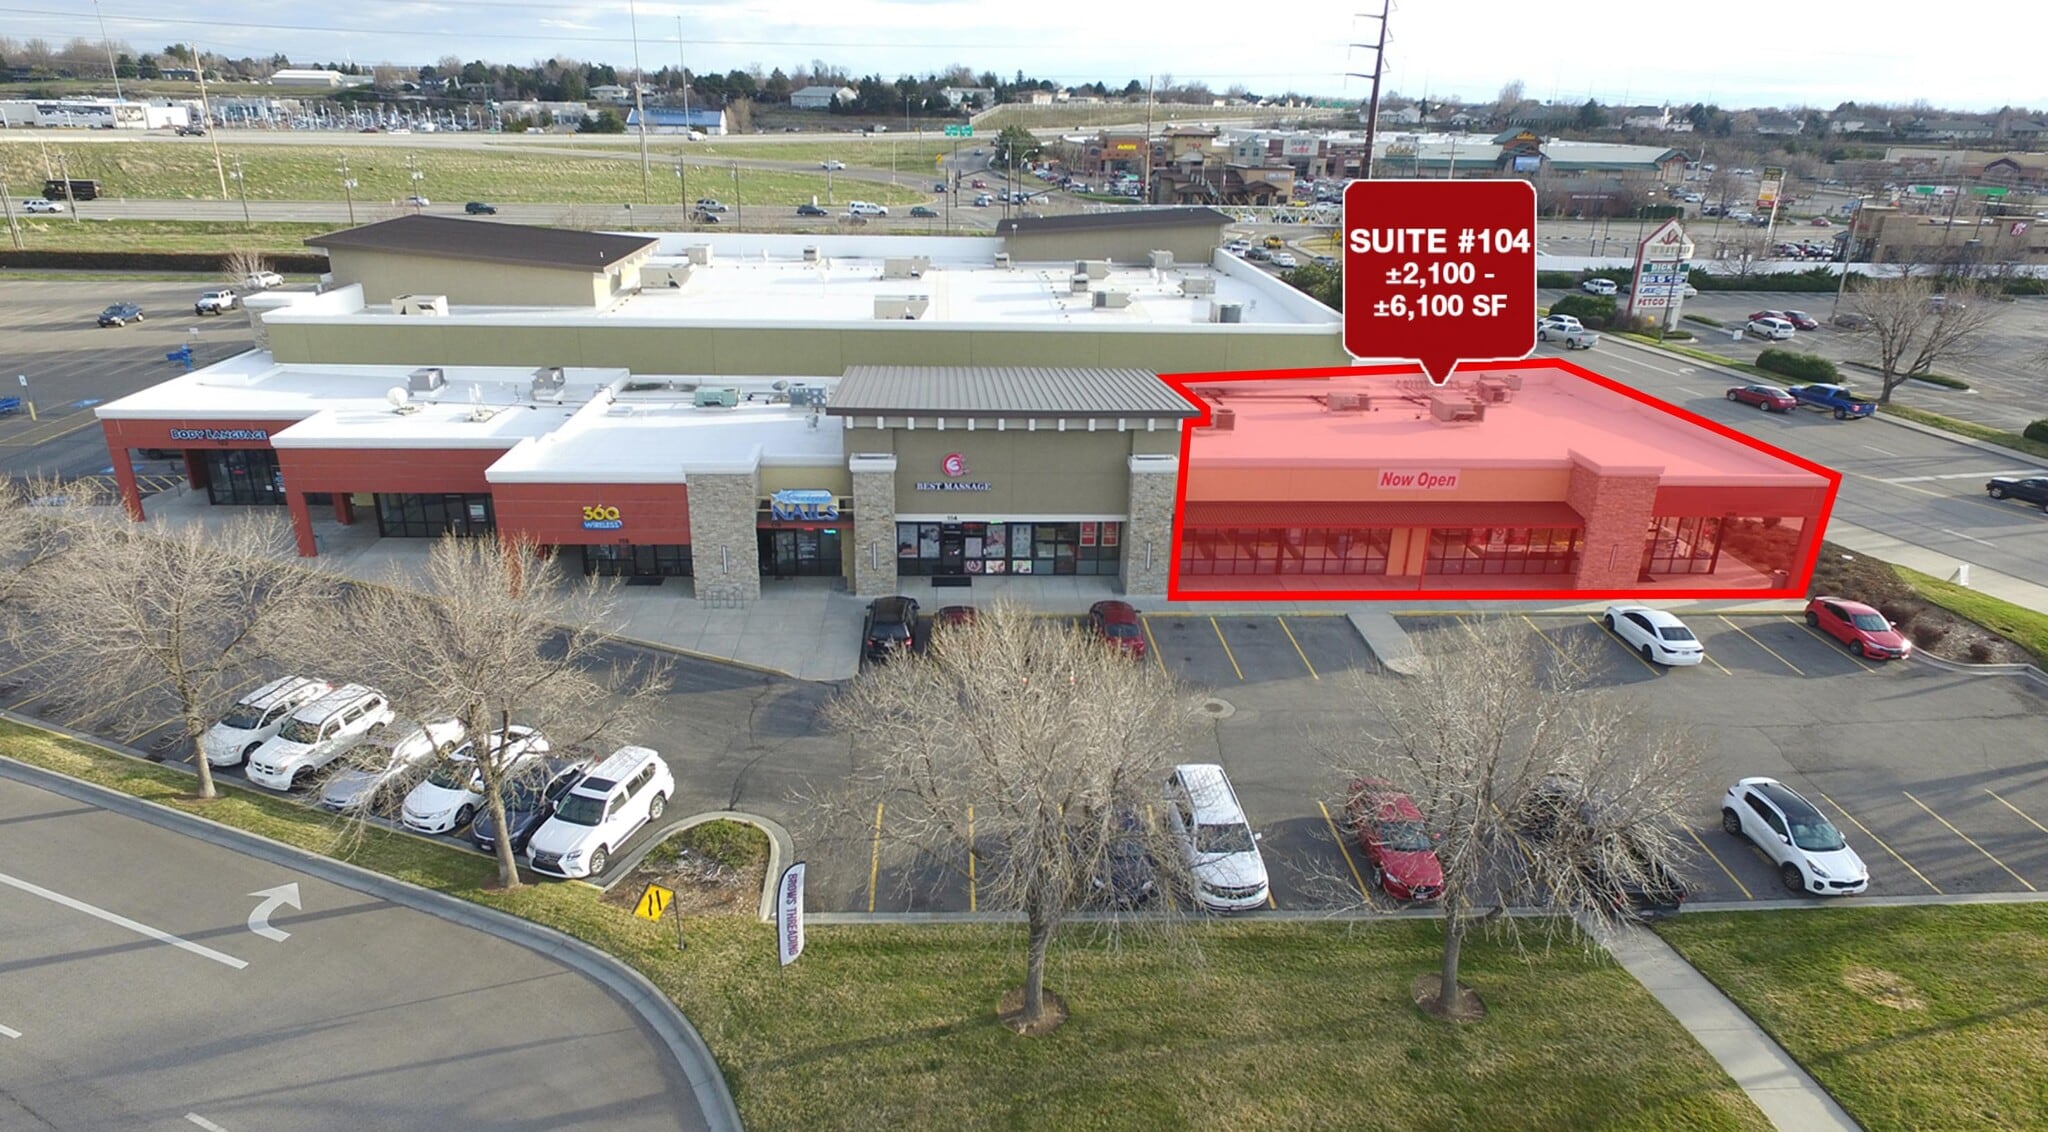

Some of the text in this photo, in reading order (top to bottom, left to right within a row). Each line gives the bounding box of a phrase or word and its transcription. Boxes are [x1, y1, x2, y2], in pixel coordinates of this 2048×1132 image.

[1637, 298, 1665, 306] PETCO
[916, 482, 993, 491] BEST MASSAGE
[1380, 472, 1457, 489] Now Open
[582, 504, 620, 521] 360
[771, 503, 839, 521] NAILS
[583, 520, 621, 529] WIRELESS
[786, 873, 799, 956] BROWS THREADING
